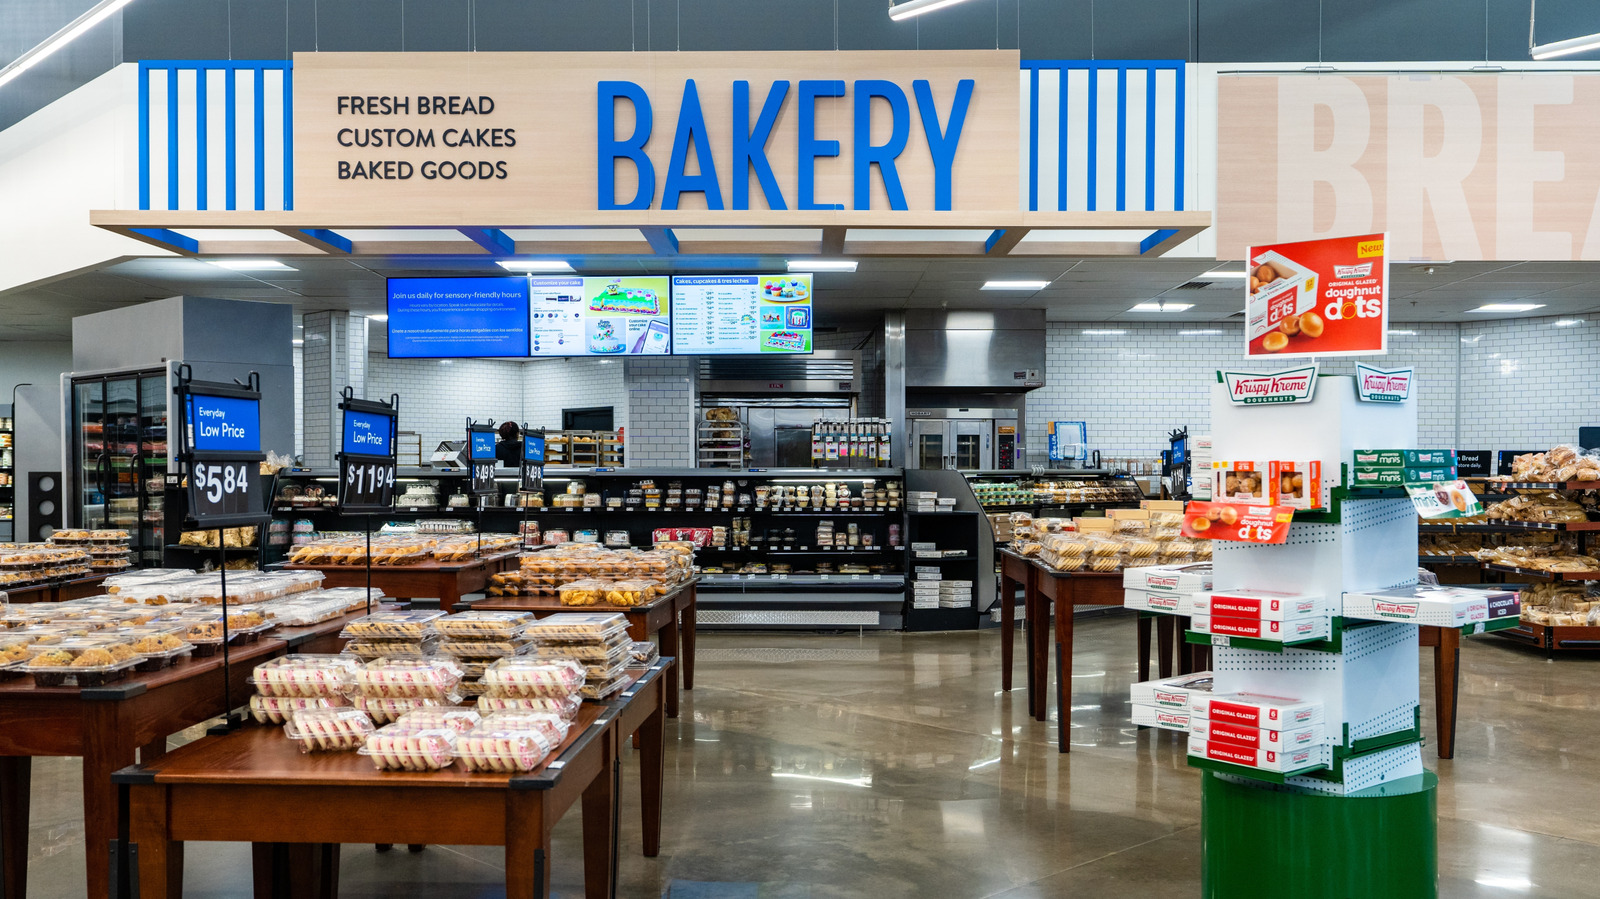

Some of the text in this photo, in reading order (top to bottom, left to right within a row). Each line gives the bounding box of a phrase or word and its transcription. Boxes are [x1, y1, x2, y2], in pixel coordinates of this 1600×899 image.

[337, 96, 495, 115] FRESH BREAD
[337, 128, 517, 147] CUSTOM CAKES
[597, 78, 975, 211] BAKERY
[337, 161, 508, 180] BAKED GOODS
[1277, 75, 1600, 260] BRE
[416, 292, 432, 300] daily
[444, 292, 500, 300] sensory-friendly
[1325, 285, 1381, 299] doughnut
[1324, 296, 1381, 320] dots
[1234, 376, 1308, 396] Krispy Kreme
[1364, 374, 1407, 393] Krispy Kreme
[199, 406, 225, 419] Everyday
[200, 422, 245, 438] Low Price
[354, 420, 370, 430] Everyday
[353, 431, 382, 445] Low Price
[195, 462, 248, 504] $584
[1240, 519, 1273, 527] doughnut
[1238, 525, 1272, 540] dots
[1493, 599, 1513, 608] CHOCOLATE
[1212, 708, 1256, 720] ORIGINAL GLAZED
[1212, 729, 1257, 741] ORIGINAL GLAZED
[1210, 749, 1254, 761] ORIGINAL GLAZED
